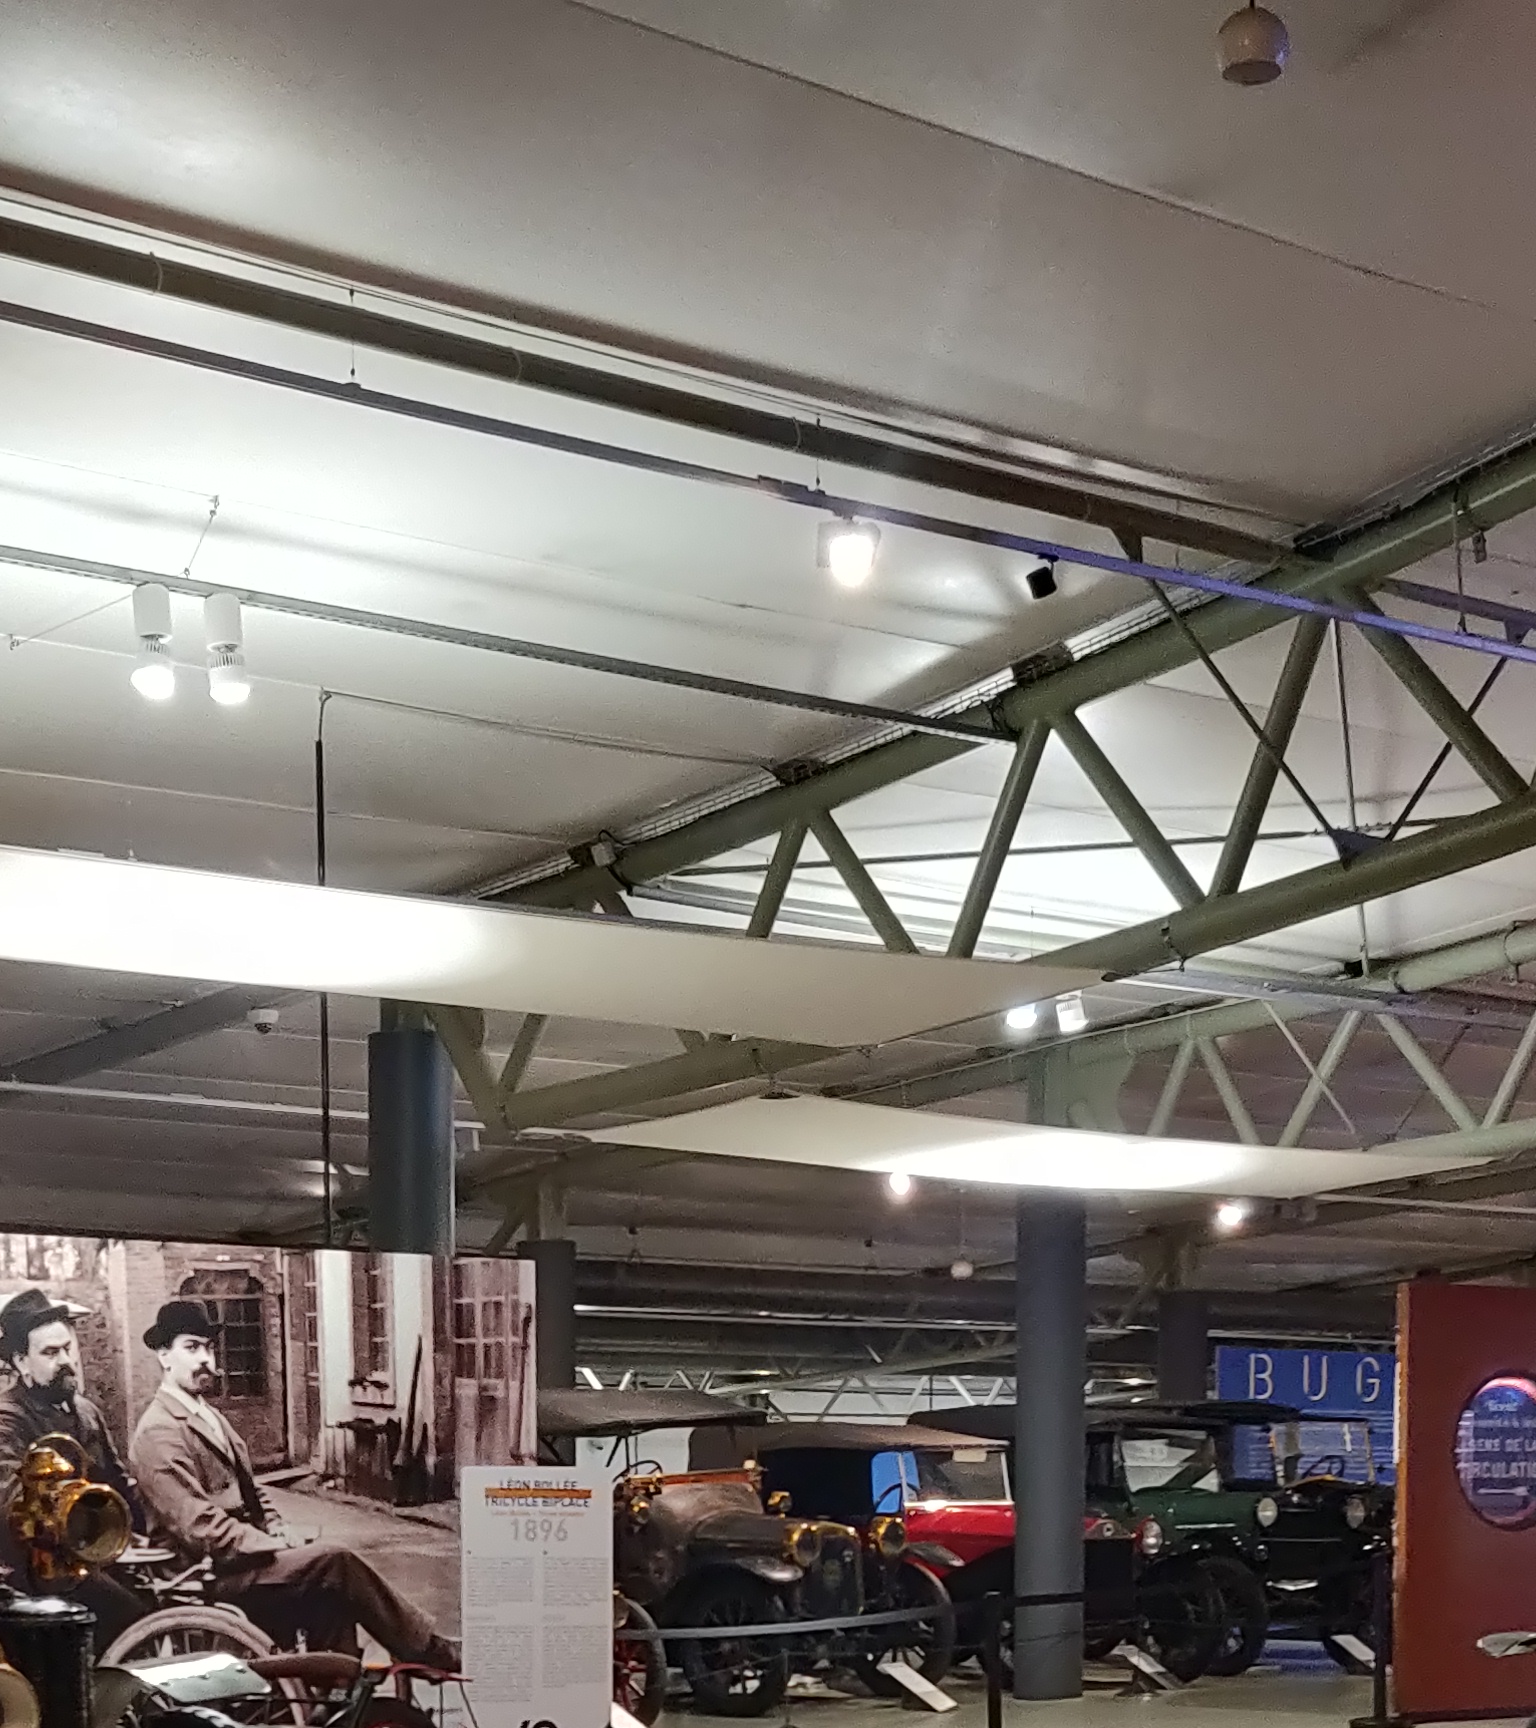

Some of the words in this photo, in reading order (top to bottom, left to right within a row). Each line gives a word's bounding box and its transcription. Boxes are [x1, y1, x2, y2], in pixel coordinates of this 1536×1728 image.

[1248, 1353, 1381, 1403] BUG
[1505, 1438, 1523, 1452] DE
[510, 1518, 569, 1541] 1896
